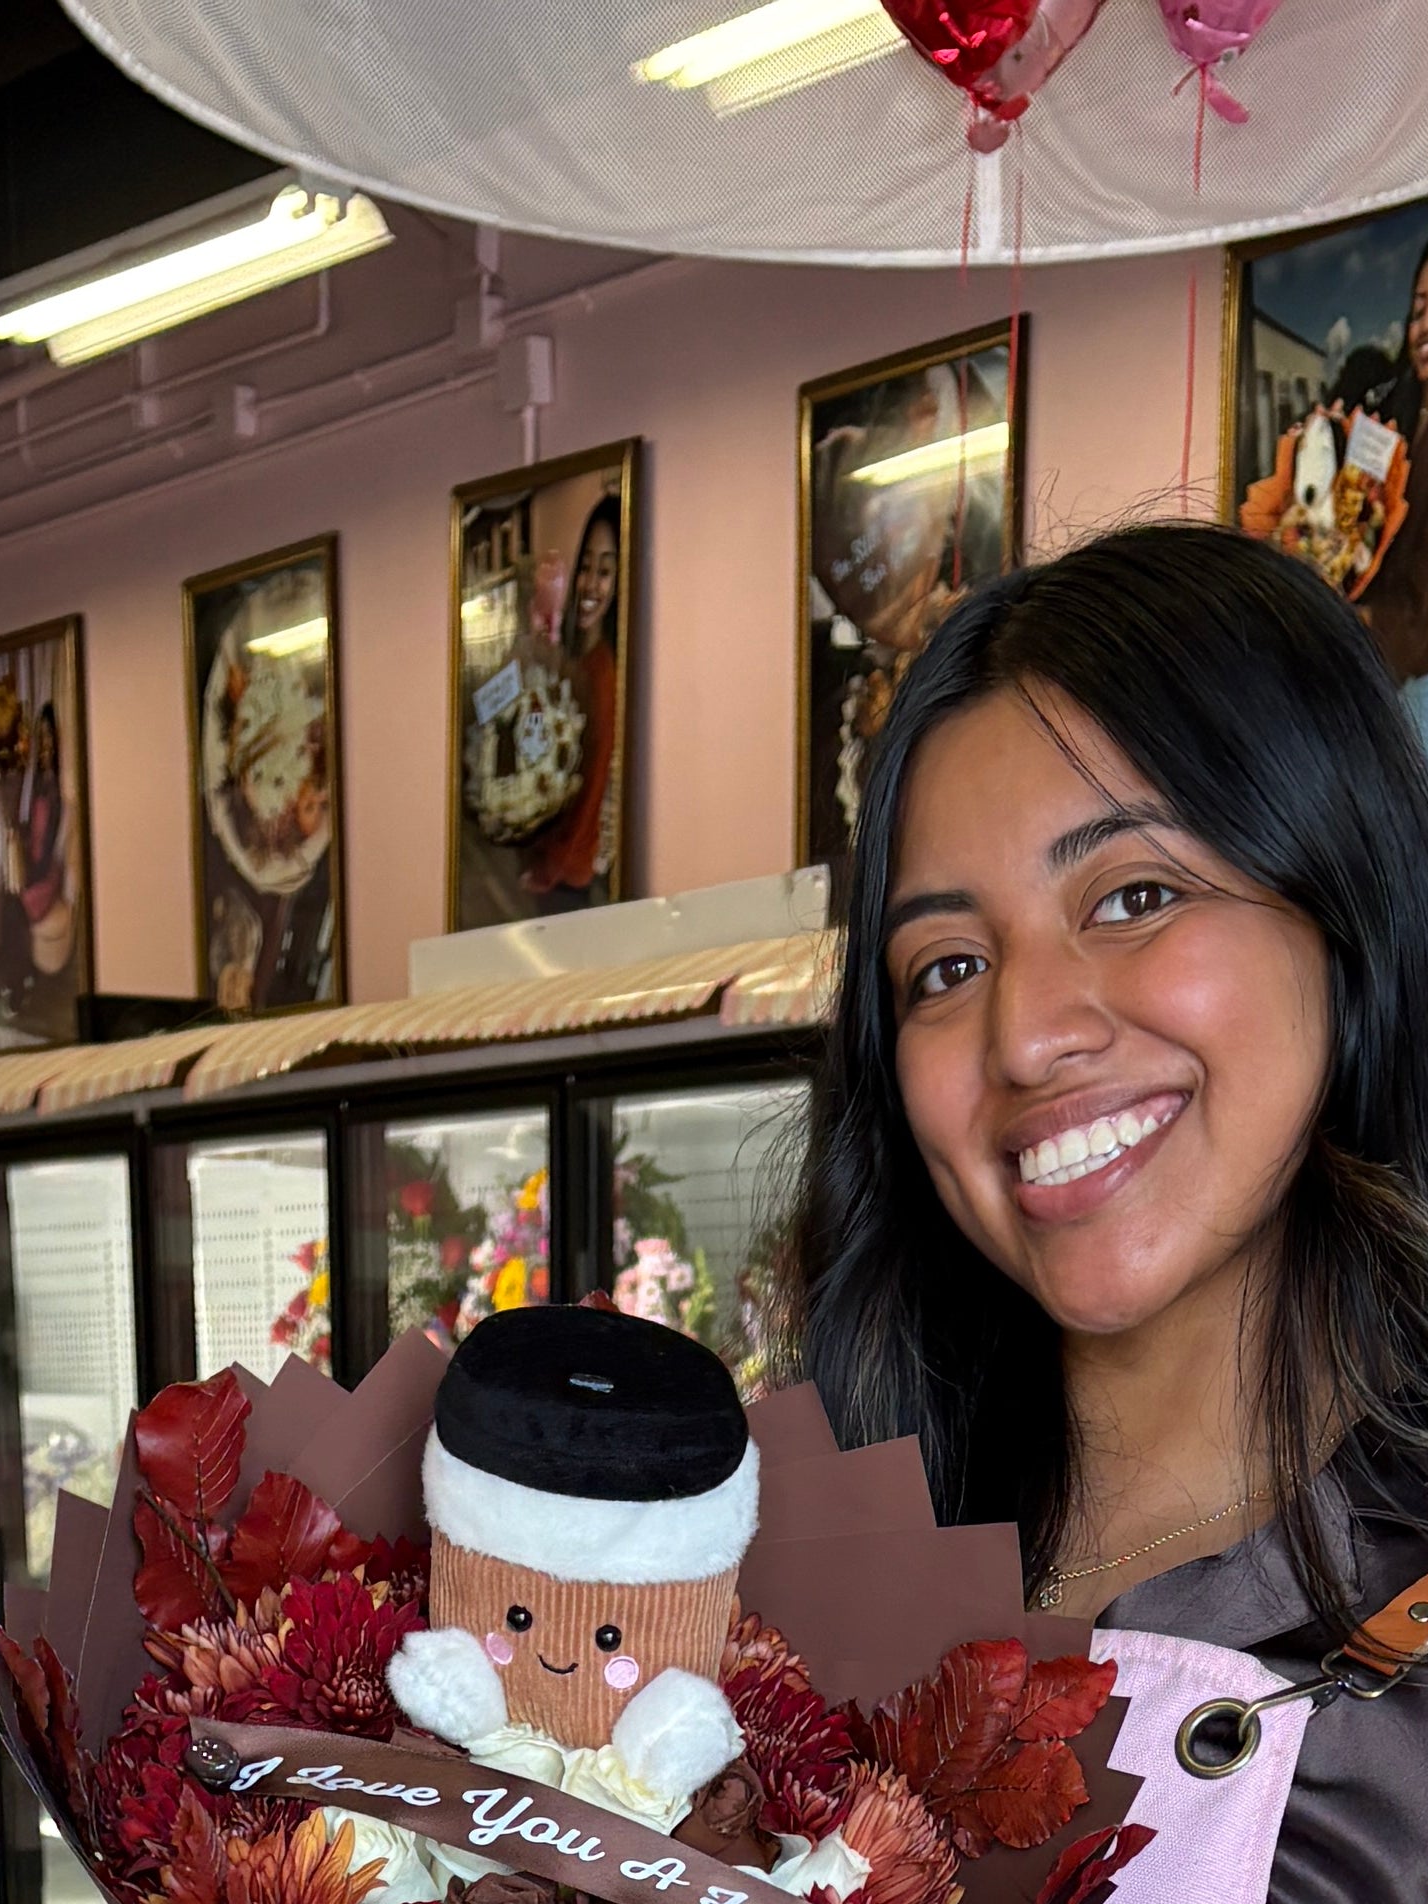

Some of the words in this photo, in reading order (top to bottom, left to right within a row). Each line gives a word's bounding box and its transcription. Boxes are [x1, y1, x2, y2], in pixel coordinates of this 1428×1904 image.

[229, 1755, 284, 1792] I
[286, 1764, 441, 1807] Love
[461, 1787, 606, 1862] You
[619, 1856, 690, 1891] A
